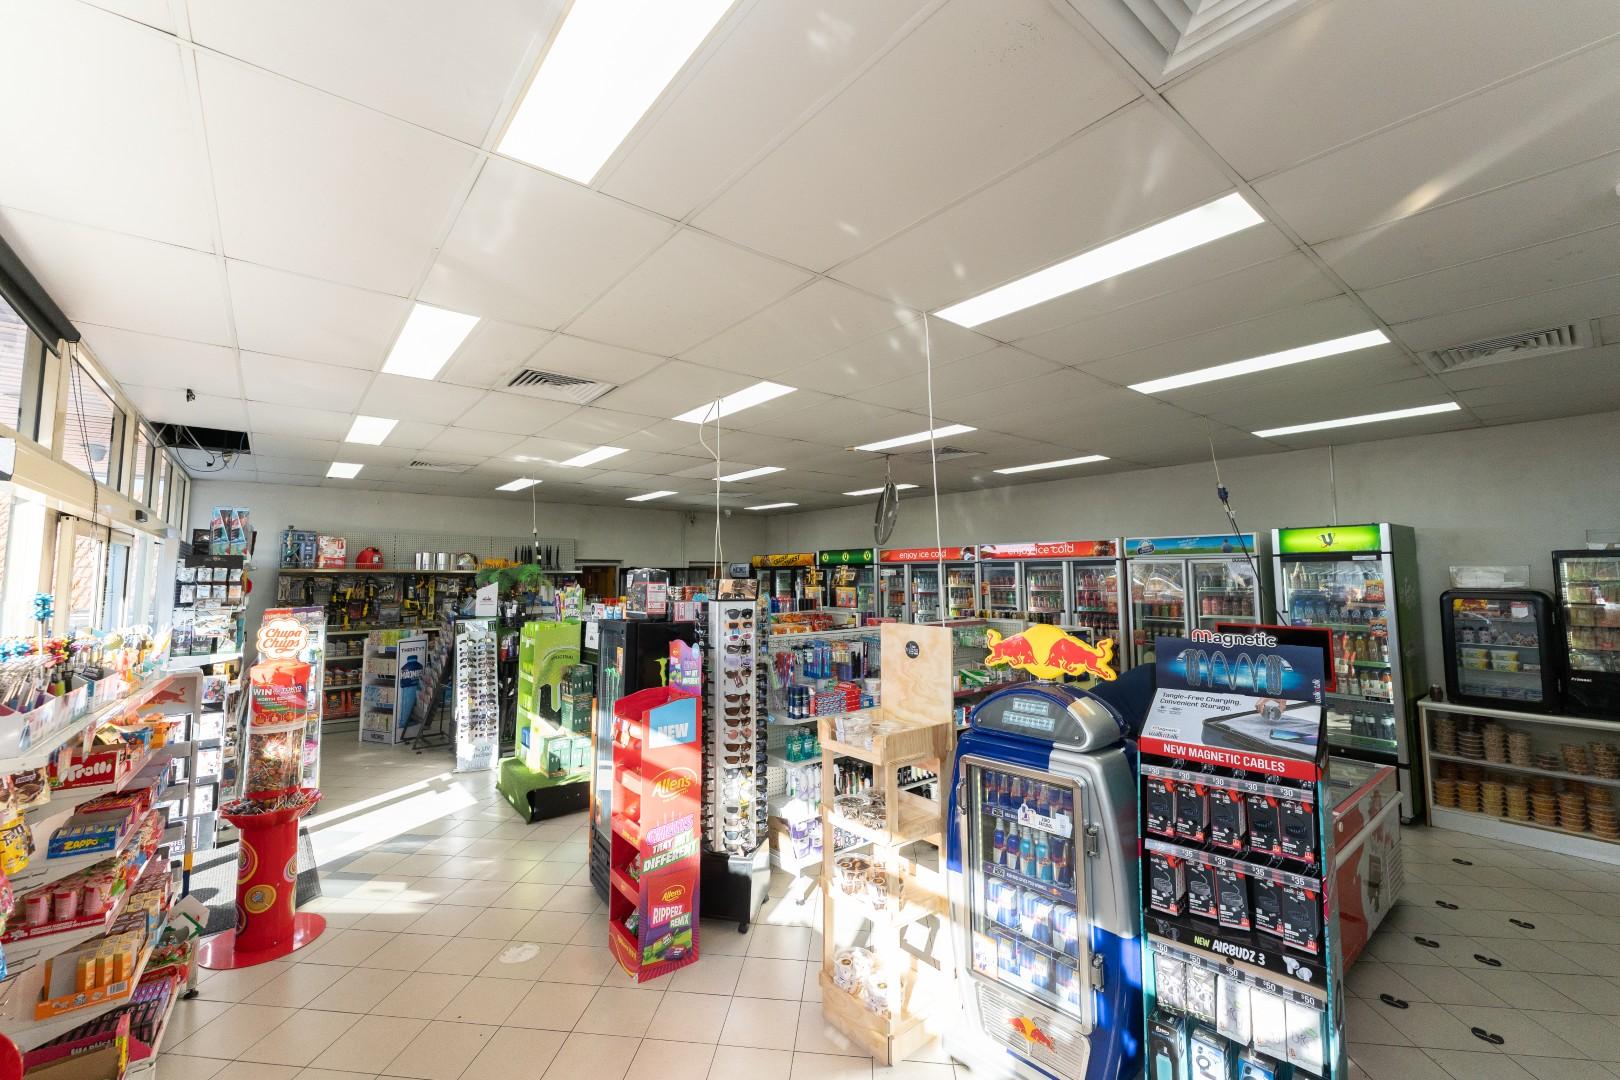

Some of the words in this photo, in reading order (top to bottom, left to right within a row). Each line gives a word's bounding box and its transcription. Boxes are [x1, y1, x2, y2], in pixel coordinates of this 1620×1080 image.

[899, 552, 917, 560] enjoy
[1036, 544, 1049, 554] ice
[1051, 544, 1074, 554] cold
[265, 628, 302, 640] Chupa
[1191, 628, 1277, 649] magnetic
[262, 639, 300, 651] Chups
[253, 688, 273, 696] WIN
[1162, 692, 1205, 702] Tangle-Free
[1205, 696, 1242, 706] Charging.
[1159, 698, 1198, 707] Convenient
[1200, 702, 1232, 712] Storage.
[657, 722, 689, 742] NEW
[1163, 743, 1187, 756] NEW
[1188, 747, 1241, 765] MAGNETIC
[1243, 756, 1286, 773] CABLES
[58, 760, 112, 782] Trolli
[651, 776, 692, 797] Allen's
[1149, 767, 1160, 775] $30
[1179, 771, 1190, 780] $30
[1212, 777, 1224, 786] $30
[1245, 783, 1257, 791] $30
[1280, 787, 1294, 798] $30
[643, 838, 698, 873] DIFFERENT
[1291, 875, 1305, 886] $35
[662, 888, 683, 901] Allen's
[652, 905, 683, 925] RIPPERZ
[670, 914, 690, 928] REMIX
[1194, 936, 1210, 948] NEW
[1211, 940, 1256, 963] AIRBUDZ
[1258, 953, 1266, 966] 3
